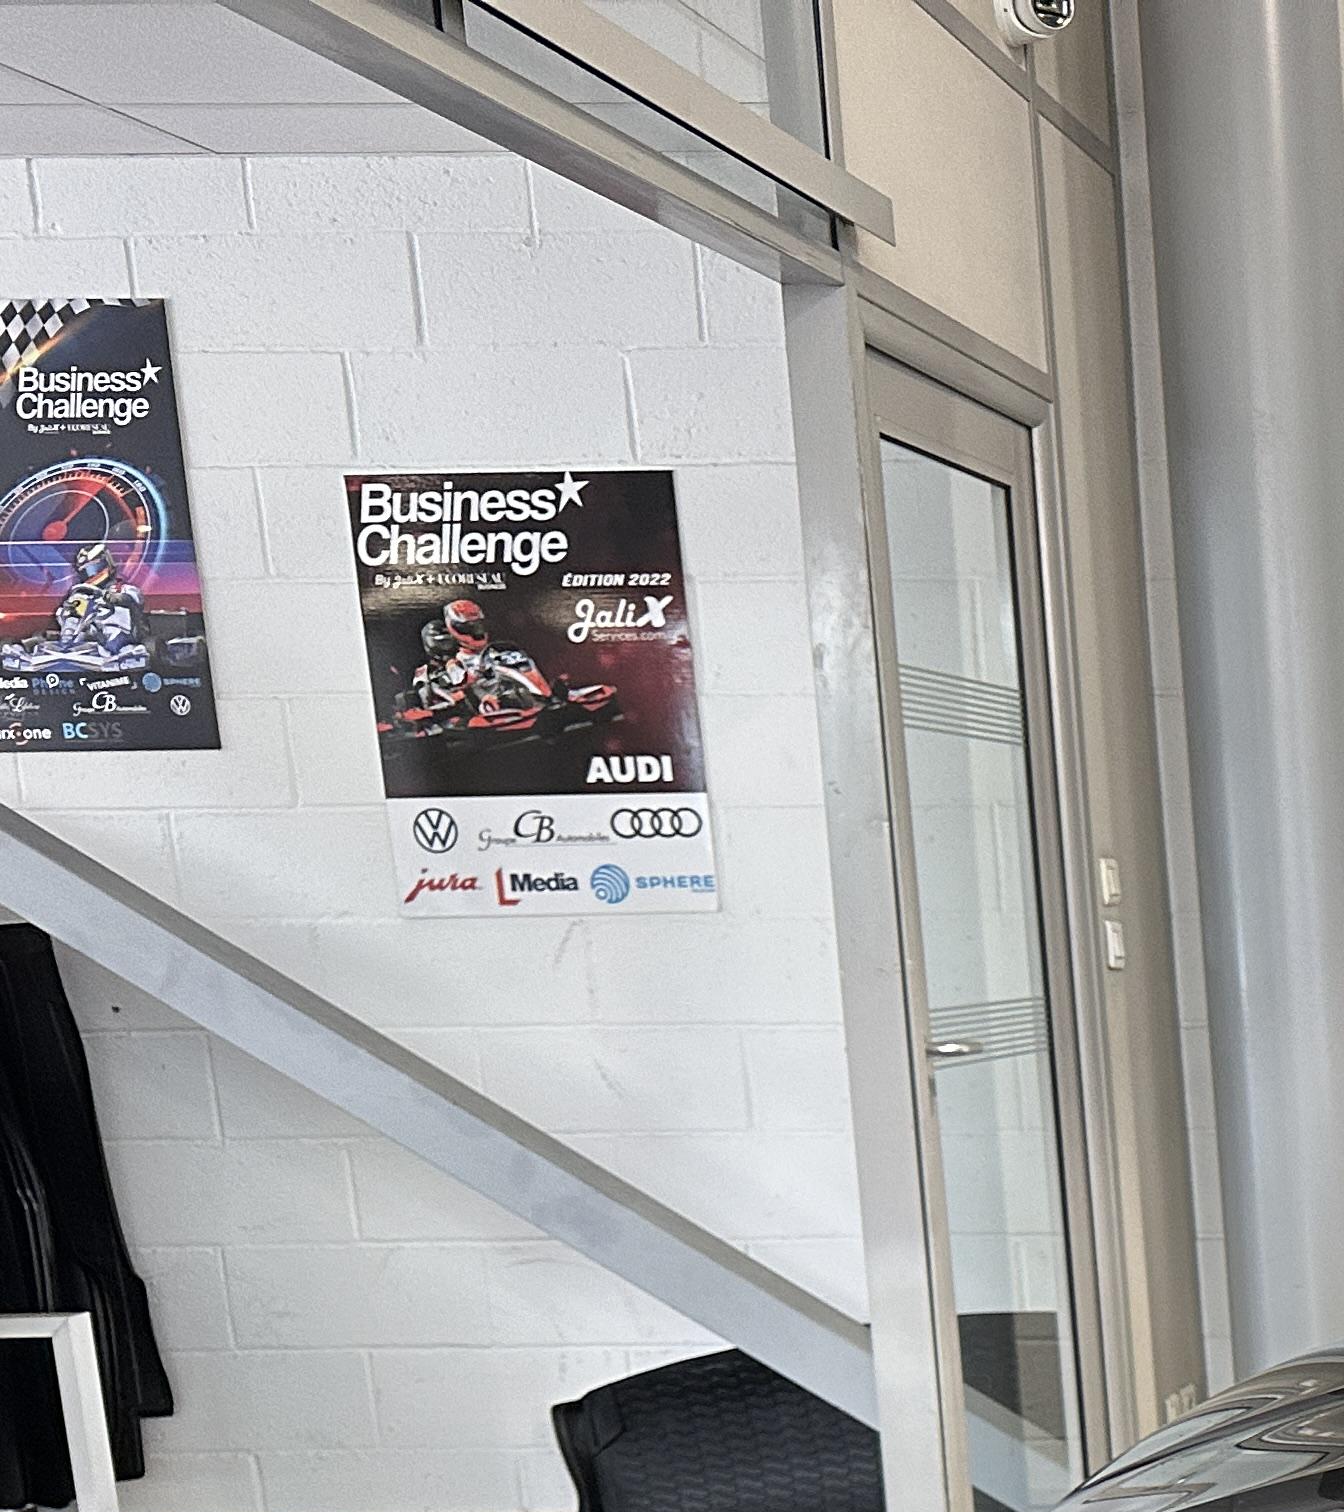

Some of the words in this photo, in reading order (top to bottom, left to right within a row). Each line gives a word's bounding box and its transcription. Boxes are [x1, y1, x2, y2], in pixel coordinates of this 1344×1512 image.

[18, 366, 142, 392] Business
[16, 393, 149, 426] Challenge
[361, 482, 557, 523] Business
[357, 524, 568, 575] Challenge
[375, 574, 390, 588] By
[562, 572, 625, 587] ÉDITION
[628, 572, 672, 587] 2022
[567, 595, 674, 643] JaliX
[586, 755, 674, 783] AUDI
[404, 868, 481, 903] jura
[636, 875, 714, 888] SPHERE
